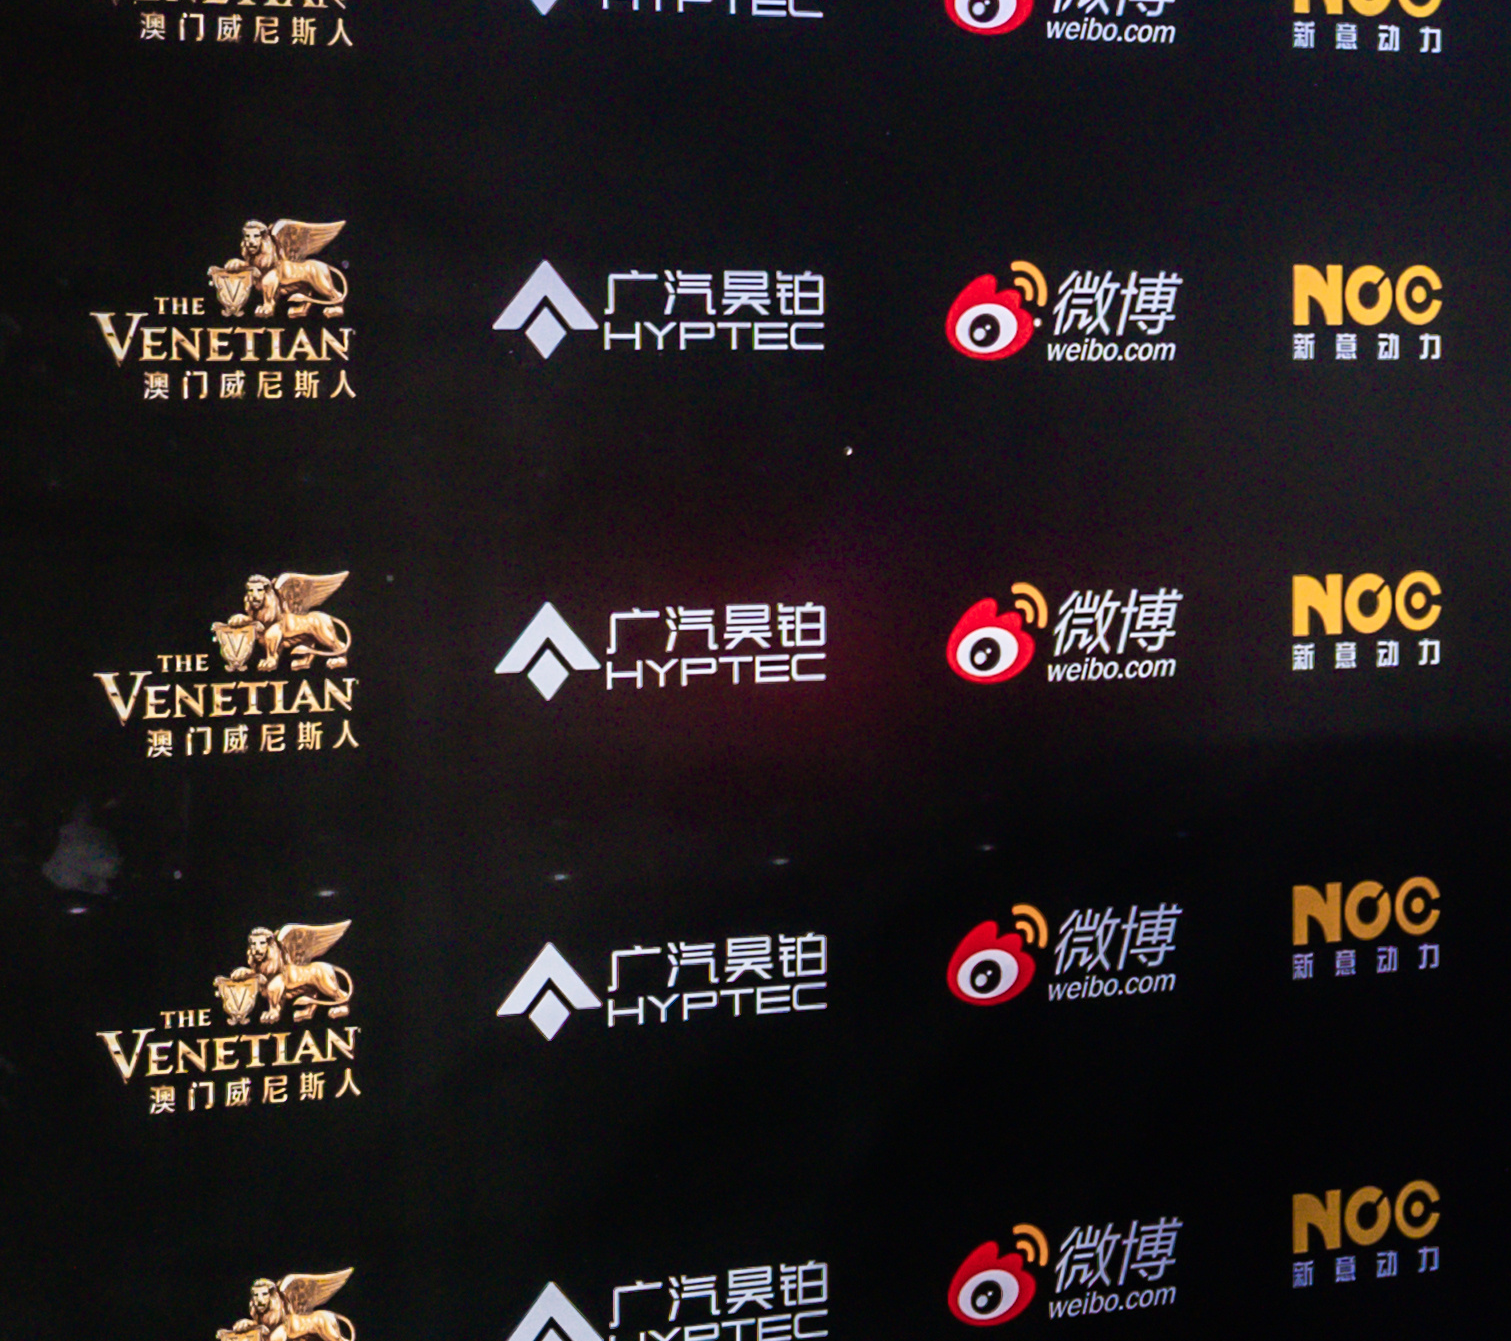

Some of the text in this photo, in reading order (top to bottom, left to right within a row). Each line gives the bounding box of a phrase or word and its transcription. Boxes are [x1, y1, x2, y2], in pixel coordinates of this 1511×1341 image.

[139, 11, 354, 47] 澳门威尼斯人
[1046, 17, 1176, 44] weibo.com
[153, 296, 206, 316] THE
[604, 269, 825, 316] 广汽昊铂
[1052, 270, 1184, 337] 微博
[1292, 263, 1443, 327] NOC
[89, 311, 353, 366] VENETIAN
[603, 321, 825, 351] HYPTEC
[1047, 338, 1177, 362] weibo.com
[143, 369, 357, 400] 澳门威尼斯人
[1053, 587, 1184, 657] 微博
[1291, 570, 1442, 637] NOC
[605, 601, 827, 655] 广汽昊铂
[156, 653, 210, 673] THE
[605, 652, 827, 691] HYPTEC
[1047, 657, 1177, 683] weibo.com
[93, 670, 360, 726] VENETIAN
[146, 719, 360, 758] 澳门威尼斯人
[1292, 876, 1441, 946] NOC
[607, 931, 827, 993] 广汽昊铂
[1054, 902, 1183, 976] 微博
[607, 981, 827, 1028] HYPTEC
[1048, 972, 1177, 1002] weibo.com
[159, 1008, 212, 1029] THE
[95, 1026, 362, 1084] VENETIAN
[149, 1067, 362, 1115] 澳门威尼斯人
[1292, 1179, 1441, 1255] NOC
[1054, 1216, 1183, 1294] 微博
[608, 1260, 828, 1329] 广汽昊铂
[1048, 1285, 1177, 1320] weibo.com
